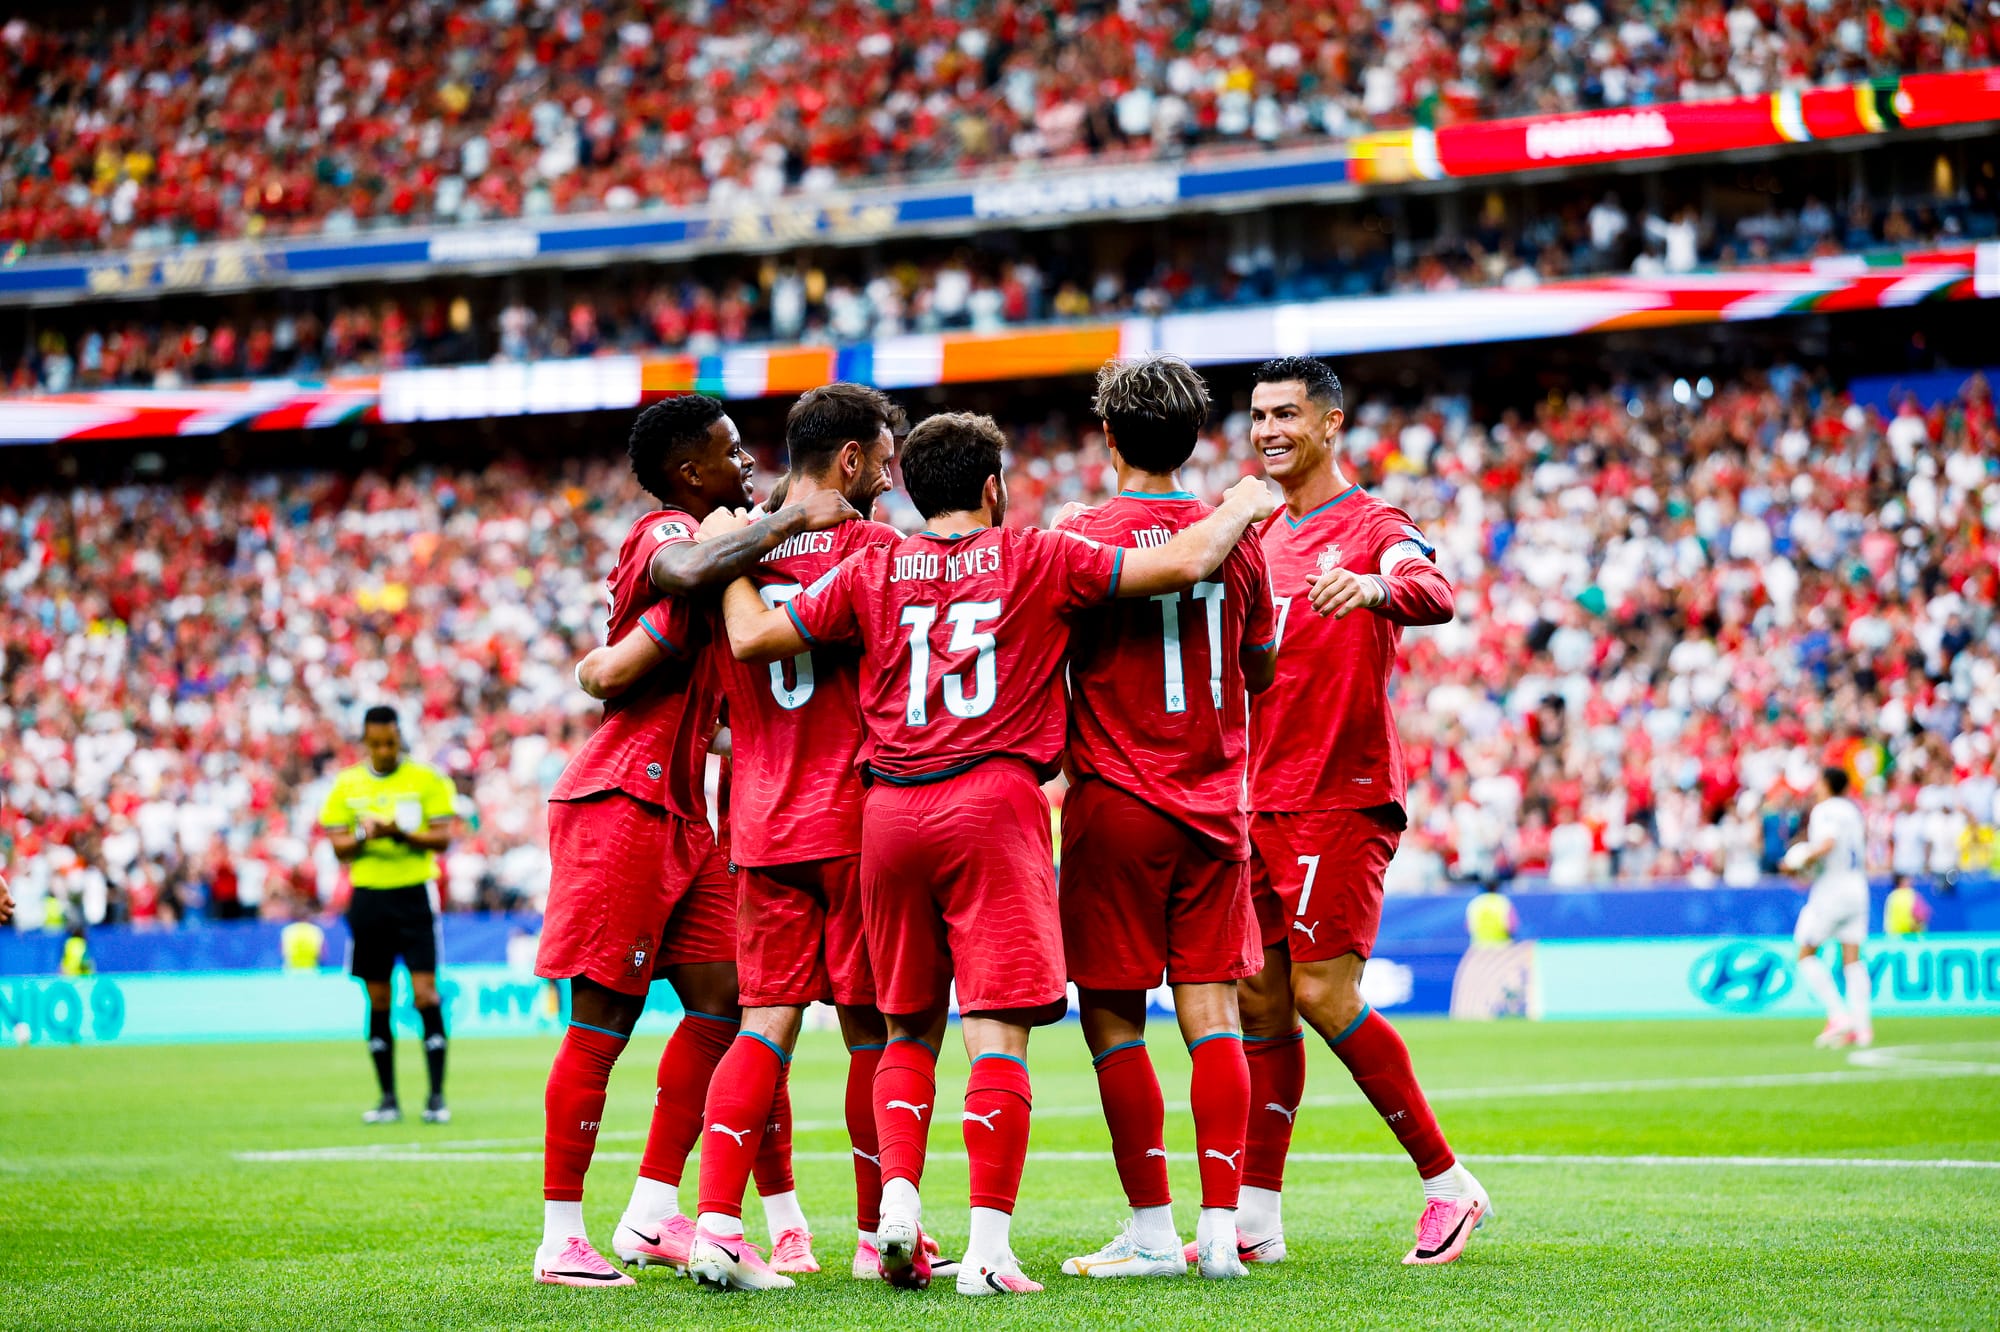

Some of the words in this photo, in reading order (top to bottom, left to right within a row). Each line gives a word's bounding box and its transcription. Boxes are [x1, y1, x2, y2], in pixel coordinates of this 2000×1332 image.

[1526, 111, 1674, 159] PORTUGAL
[889, 551, 939, 583] JOÃO
[944, 545, 1000, 582] NEVES
[899, 598, 1003, 727] 15
[1149, 581, 1226, 713] 11
[1296, 854, 1321, 916] 7
[91, 981, 125, 1041] 9
